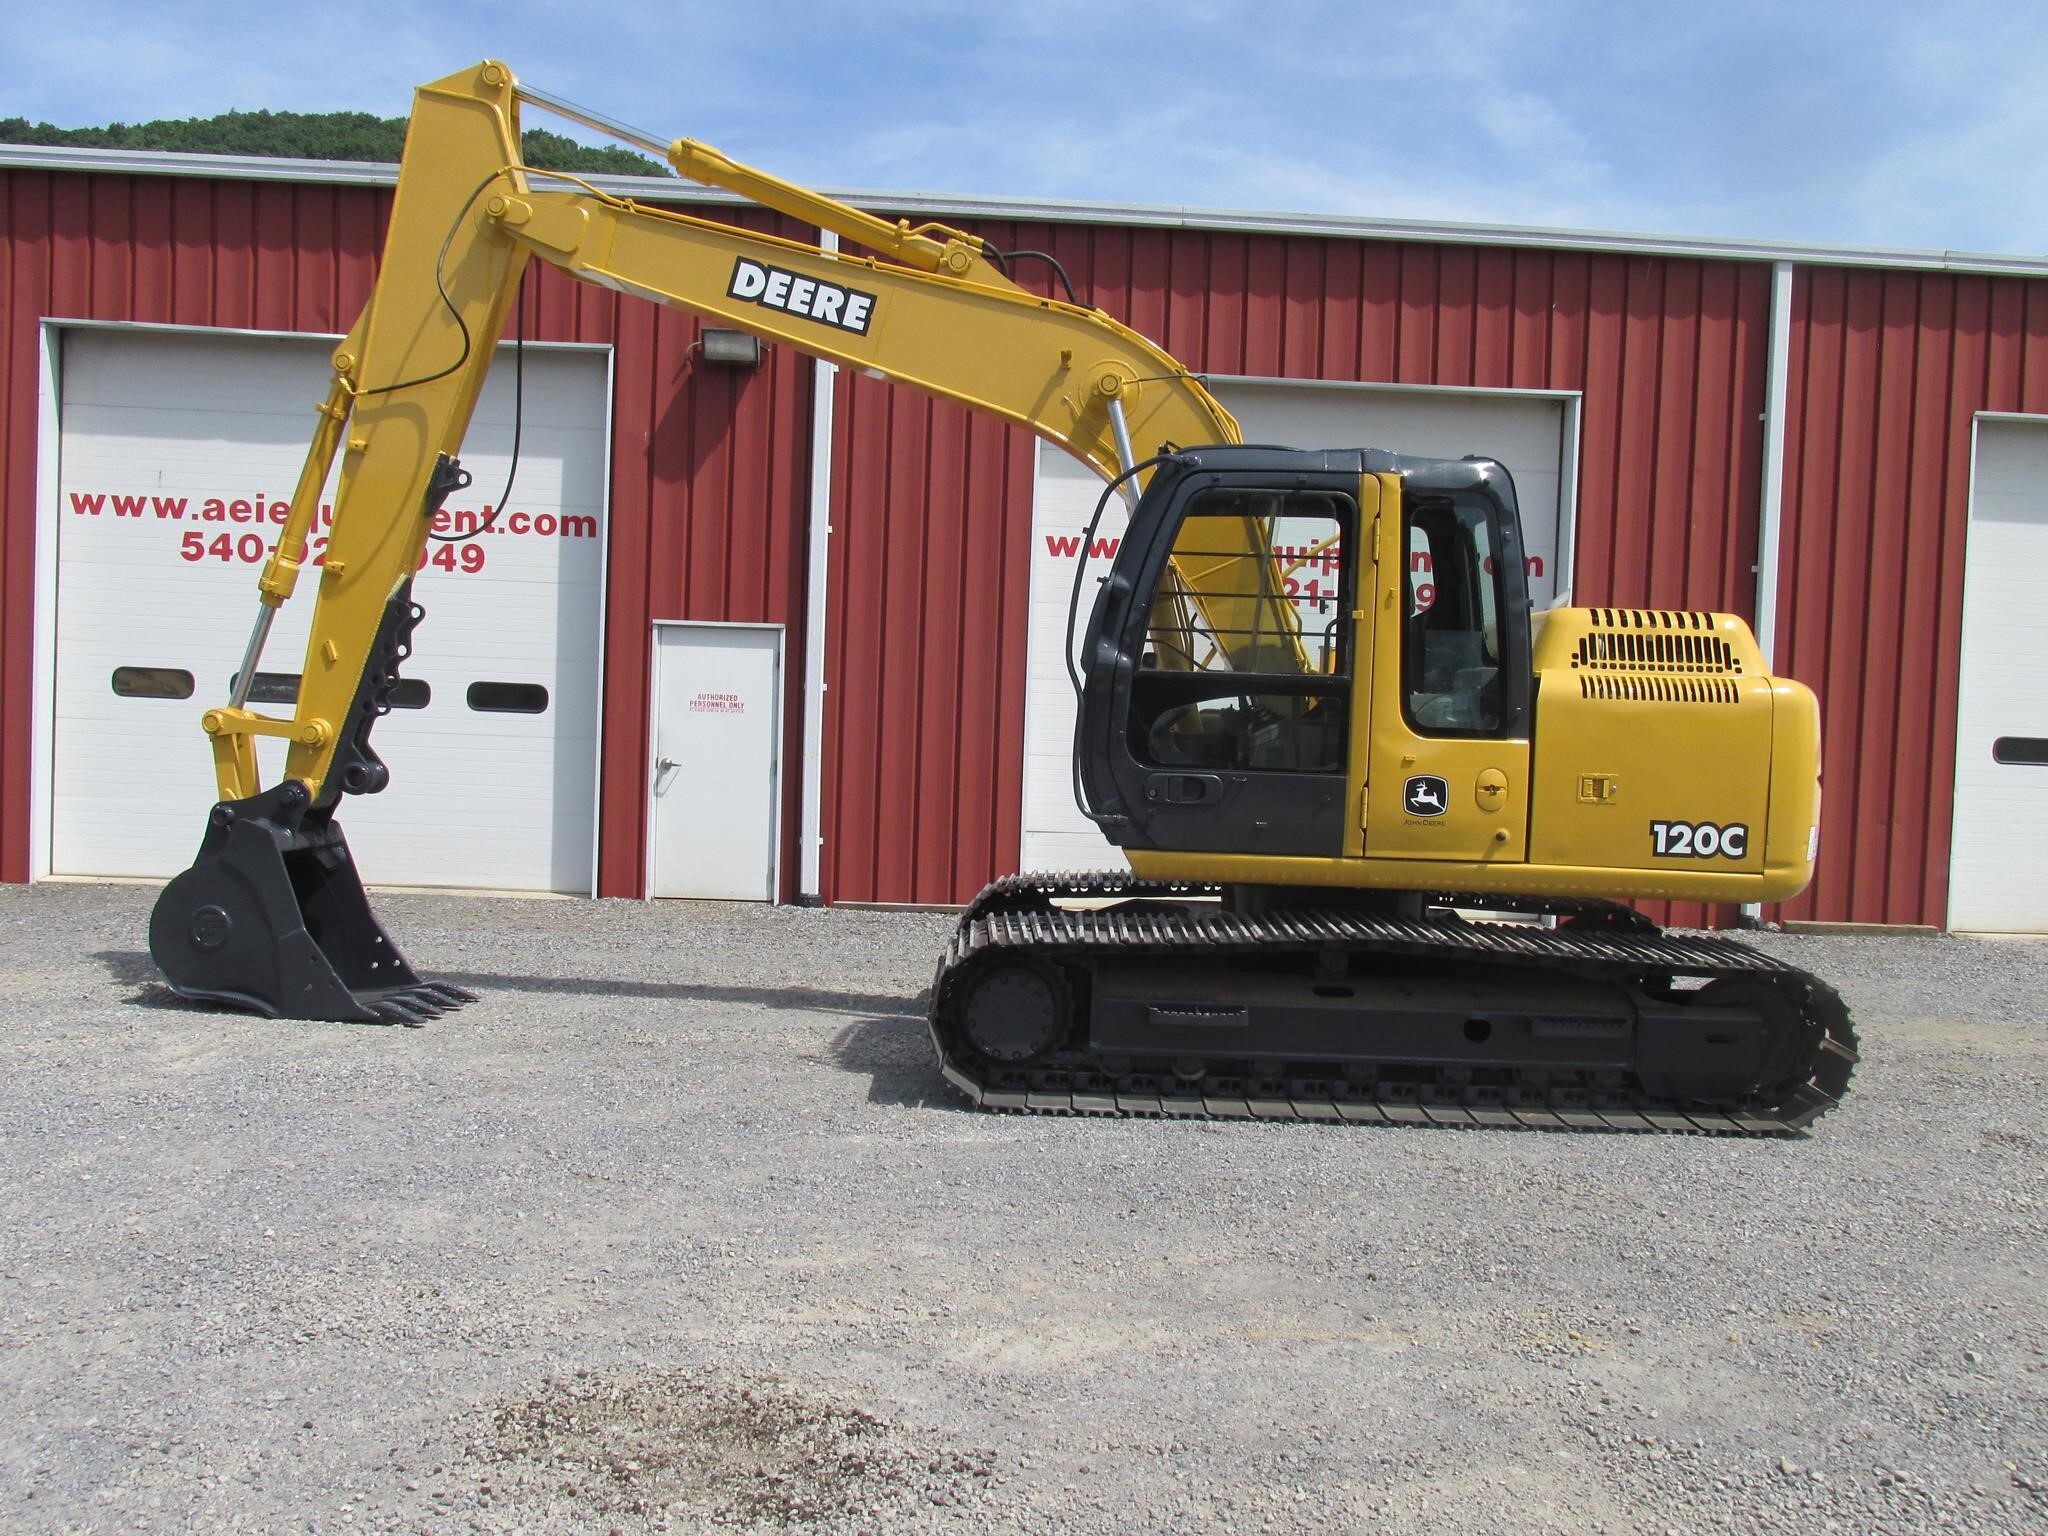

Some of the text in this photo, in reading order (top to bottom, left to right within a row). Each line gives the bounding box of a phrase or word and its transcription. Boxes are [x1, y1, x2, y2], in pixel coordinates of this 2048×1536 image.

[732, 261, 872, 331] DEERE
[689, 700, 727, 709] PERSONNEL
[697, 693, 738, 702] AUTHORIZED
[1653, 824, 1745, 856] 120C
